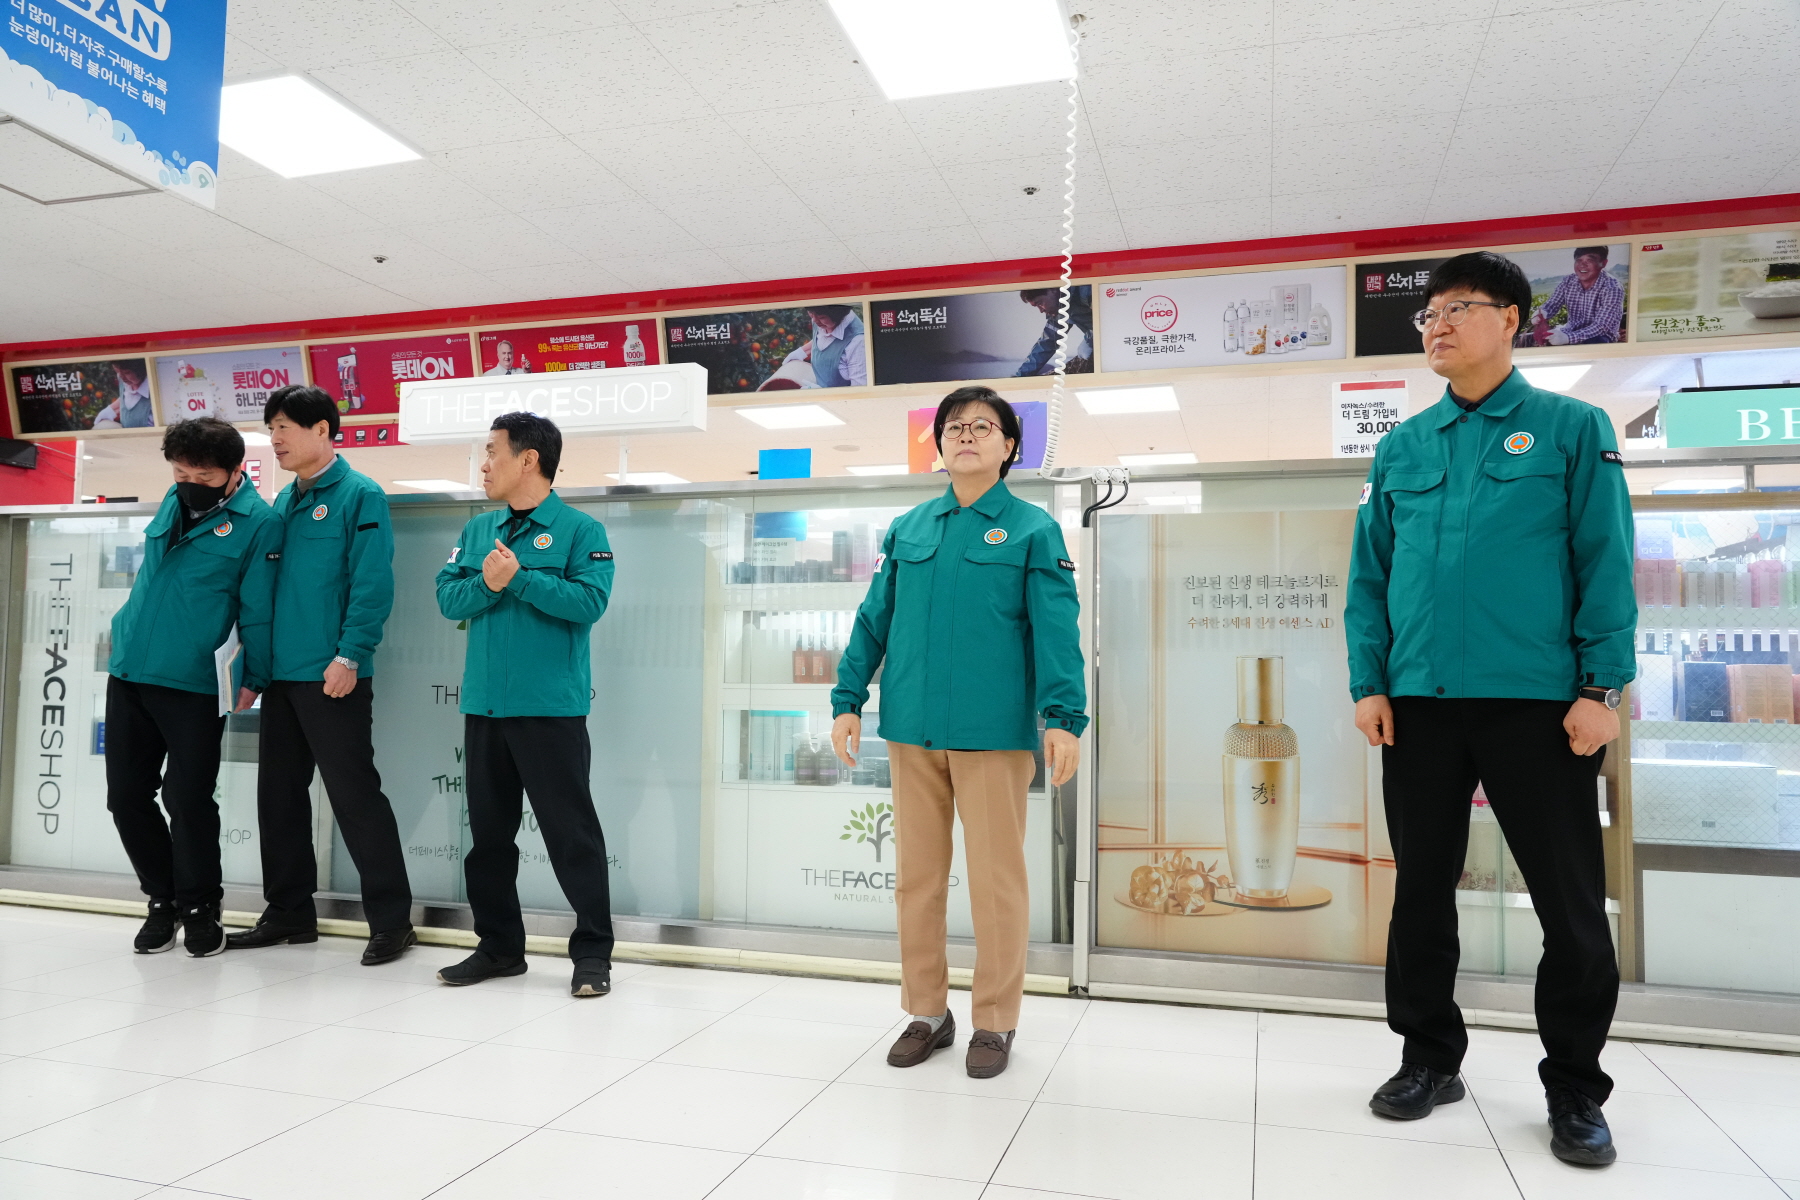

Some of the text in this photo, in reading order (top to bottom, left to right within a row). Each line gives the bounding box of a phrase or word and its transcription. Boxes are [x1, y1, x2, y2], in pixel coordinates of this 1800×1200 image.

[68, 0, 160, 53] AN
[28, 4, 60, 36] 많이,
[63, 24, 77, 44] 더
[79, 32, 106, 58] 자주
[107, 49, 168, 95] 구매할수록
[9, 16, 167, 115] 눈덩이처럼 불어나는 혜택
[1386, 270, 1430, 290] 산지뚝
[896, 306, 948, 325] 산지뚝심
[1144, 308, 1174, 320] price
[685, 322, 731, 341] 산지뚝심
[1135, 344, 1185, 356] 온리프라이스
[391, 356, 455, 380] 롯데ON
[35, 371, 83, 392] 산지뚝심
[232, 368, 290, 390] 롯데ON
[187, 398, 206, 411] ON
[235, 391, 267, 408] 하나면
[419, 380, 672, 425] THEFACESHOP
[1342, 408, 1398, 420] 더 드림 가입비
[1224, 575, 1252, 590] 진생
[1192, 593, 1328, 610] 더 진하게, 더 강력하게
[801, 868, 960, 890] THEFACEP
[834, 893, 883, 904] NATURAL
